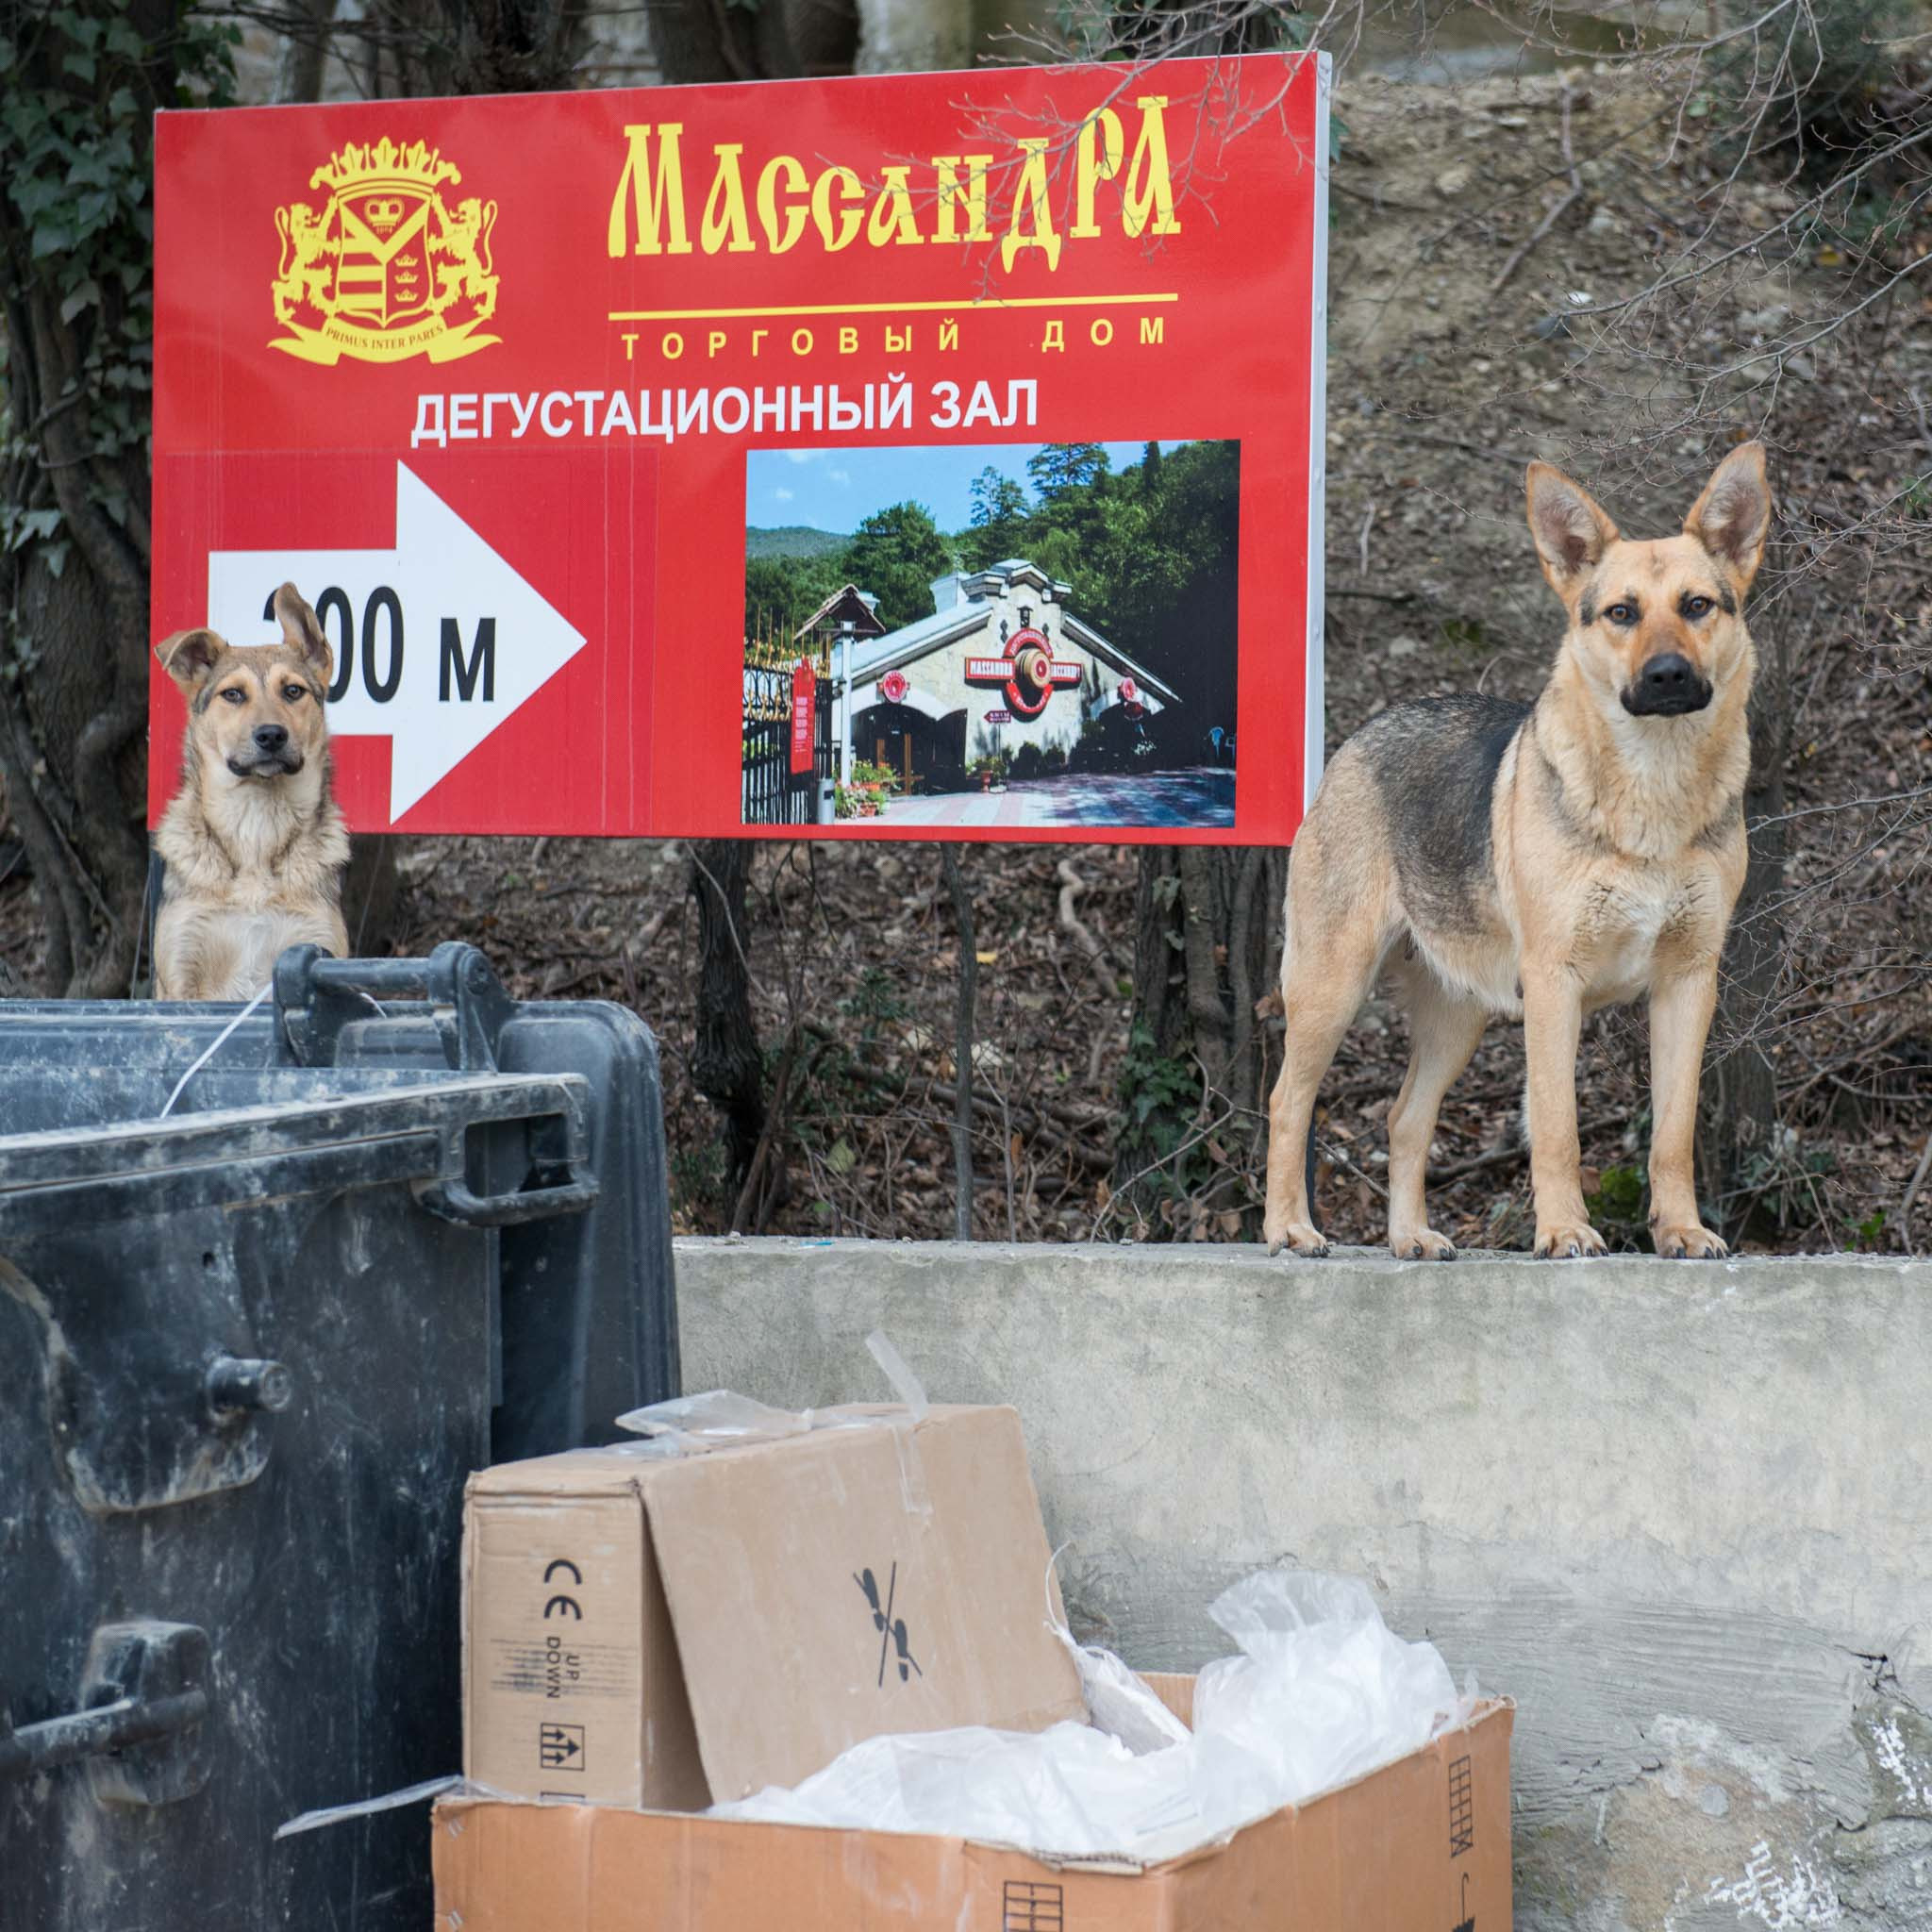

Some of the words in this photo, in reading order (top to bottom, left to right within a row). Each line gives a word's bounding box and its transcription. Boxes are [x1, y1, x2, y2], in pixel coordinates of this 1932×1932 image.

[326, 326, 368, 348] PRIMUS
[372, 338, 406, 350] INTER
[409, 325, 443, 345] PARES
[622, 318, 958, 361] ТОРГОВЫЙ
[1041, 317, 1164, 354] ДОМ
[409, 372, 914, 448] ДЕГУСТАЦИОННЫЙ
[929, 378, 1039, 428] ЗАЛ
[263, 585, 405, 704] 00
[546, 1636, 561, 1699] DOWN
[566, 1655, 580, 1681] UP
